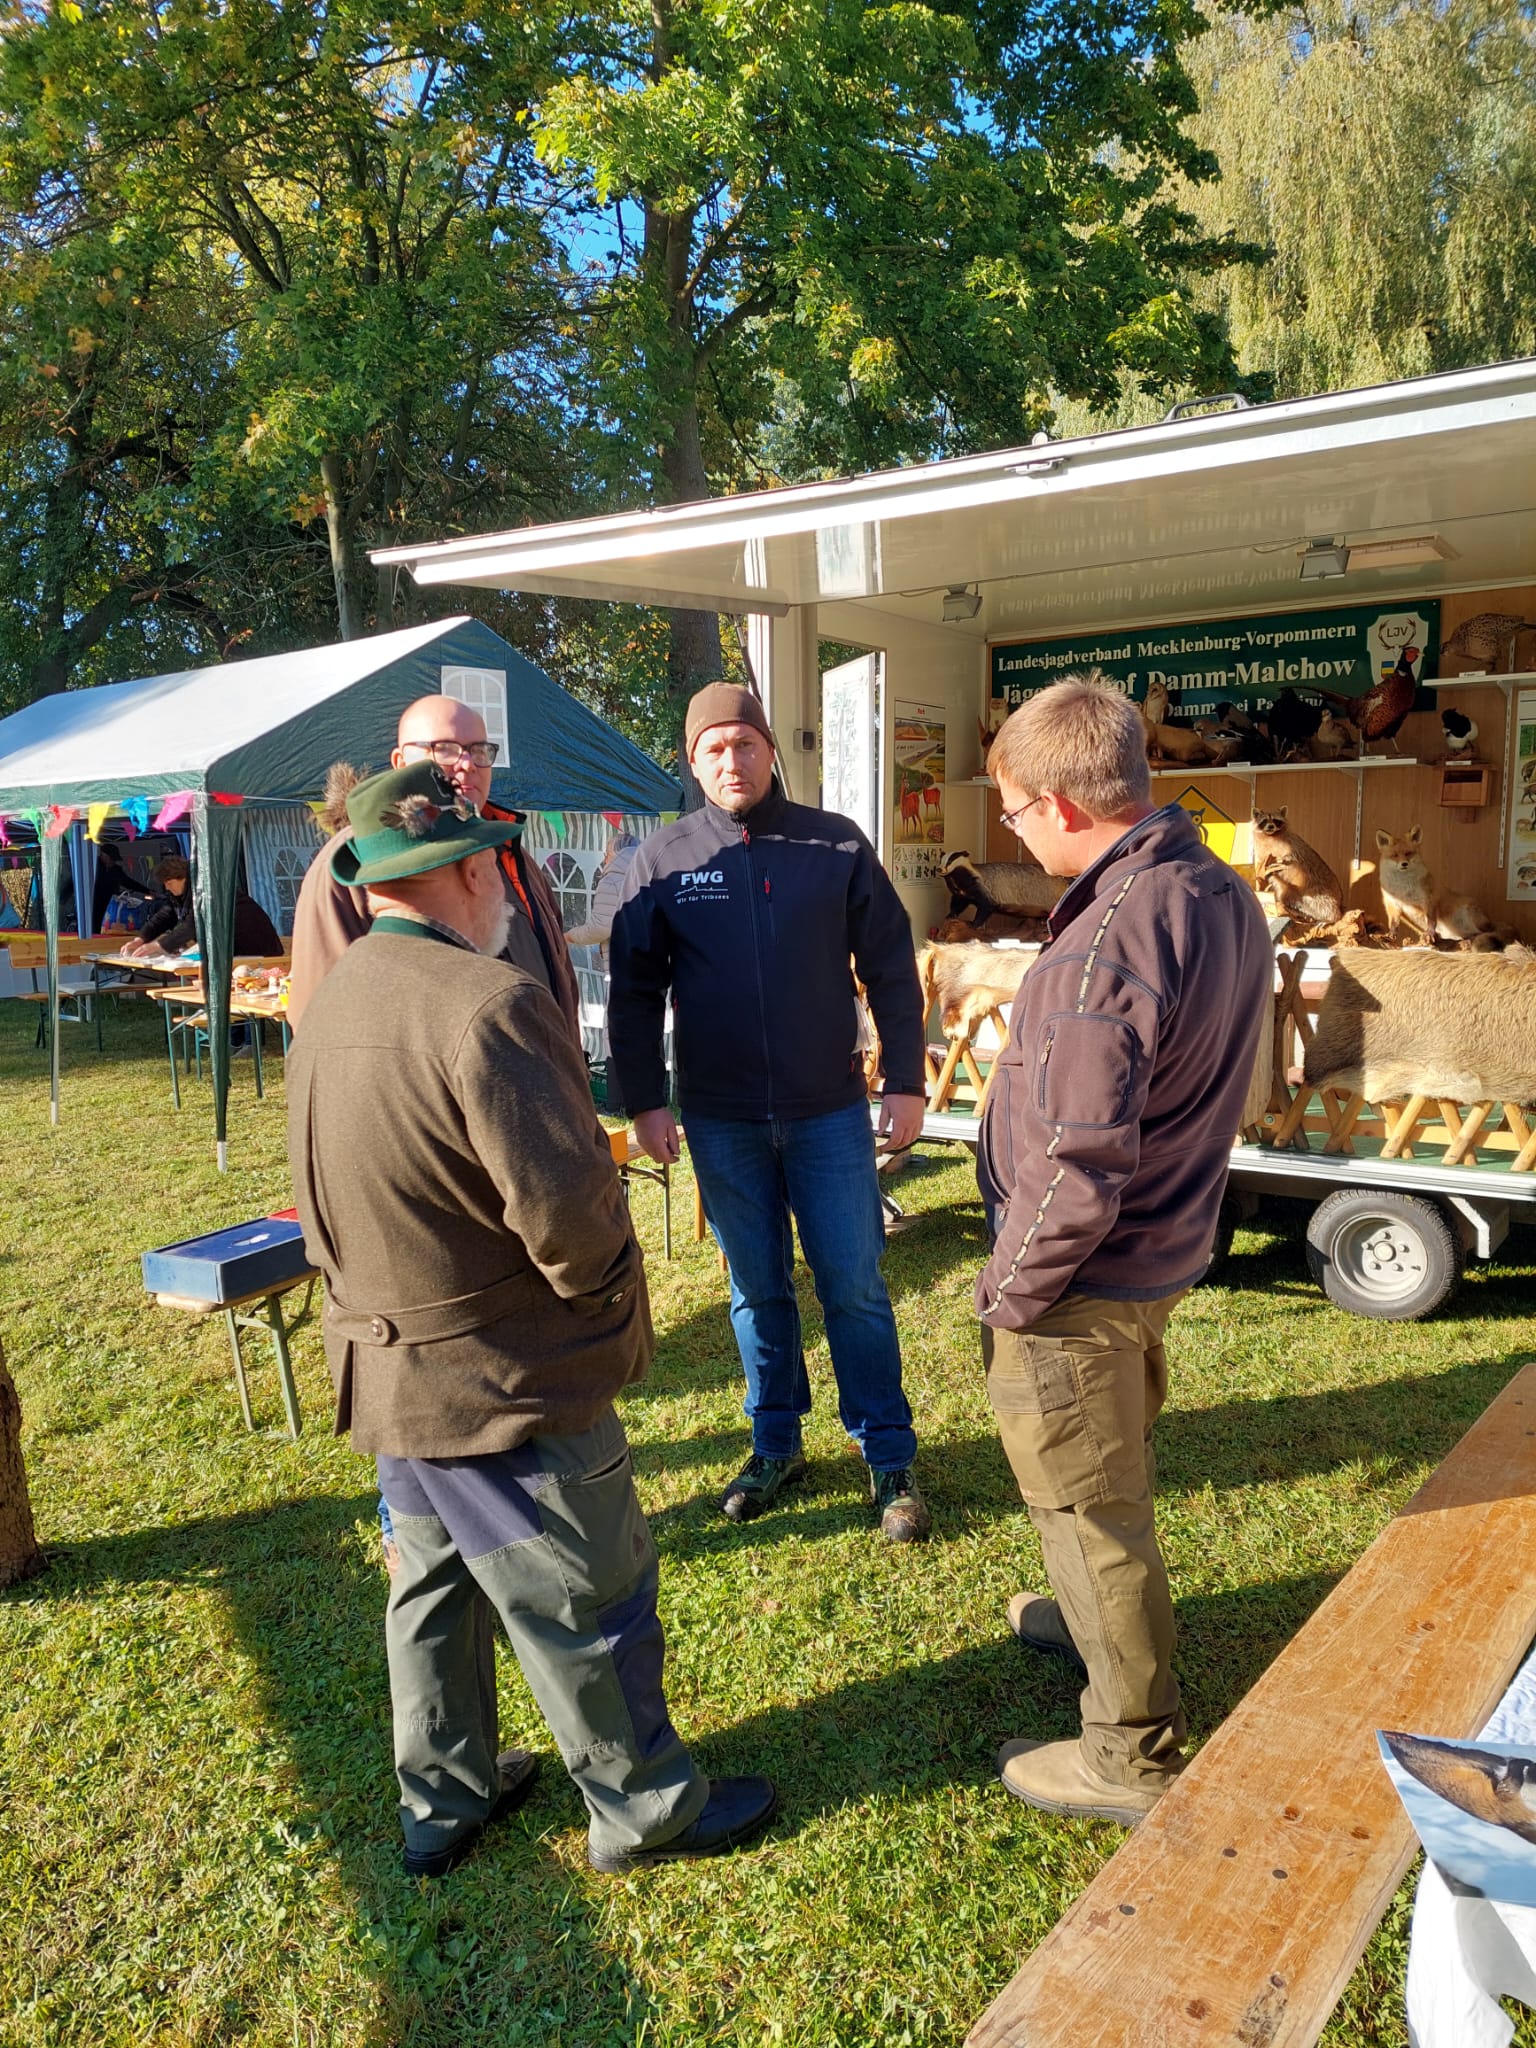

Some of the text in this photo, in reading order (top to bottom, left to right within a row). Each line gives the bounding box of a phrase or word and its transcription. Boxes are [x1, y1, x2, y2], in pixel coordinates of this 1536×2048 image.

[1386, 626, 1409, 638] LJV
[998, 624, 1357, 672] Landesjagdverband Mecklenburg-Vorpommern
[1147, 657, 1357, 691] Damm-Malchow
[681, 870, 724, 886] FWG
